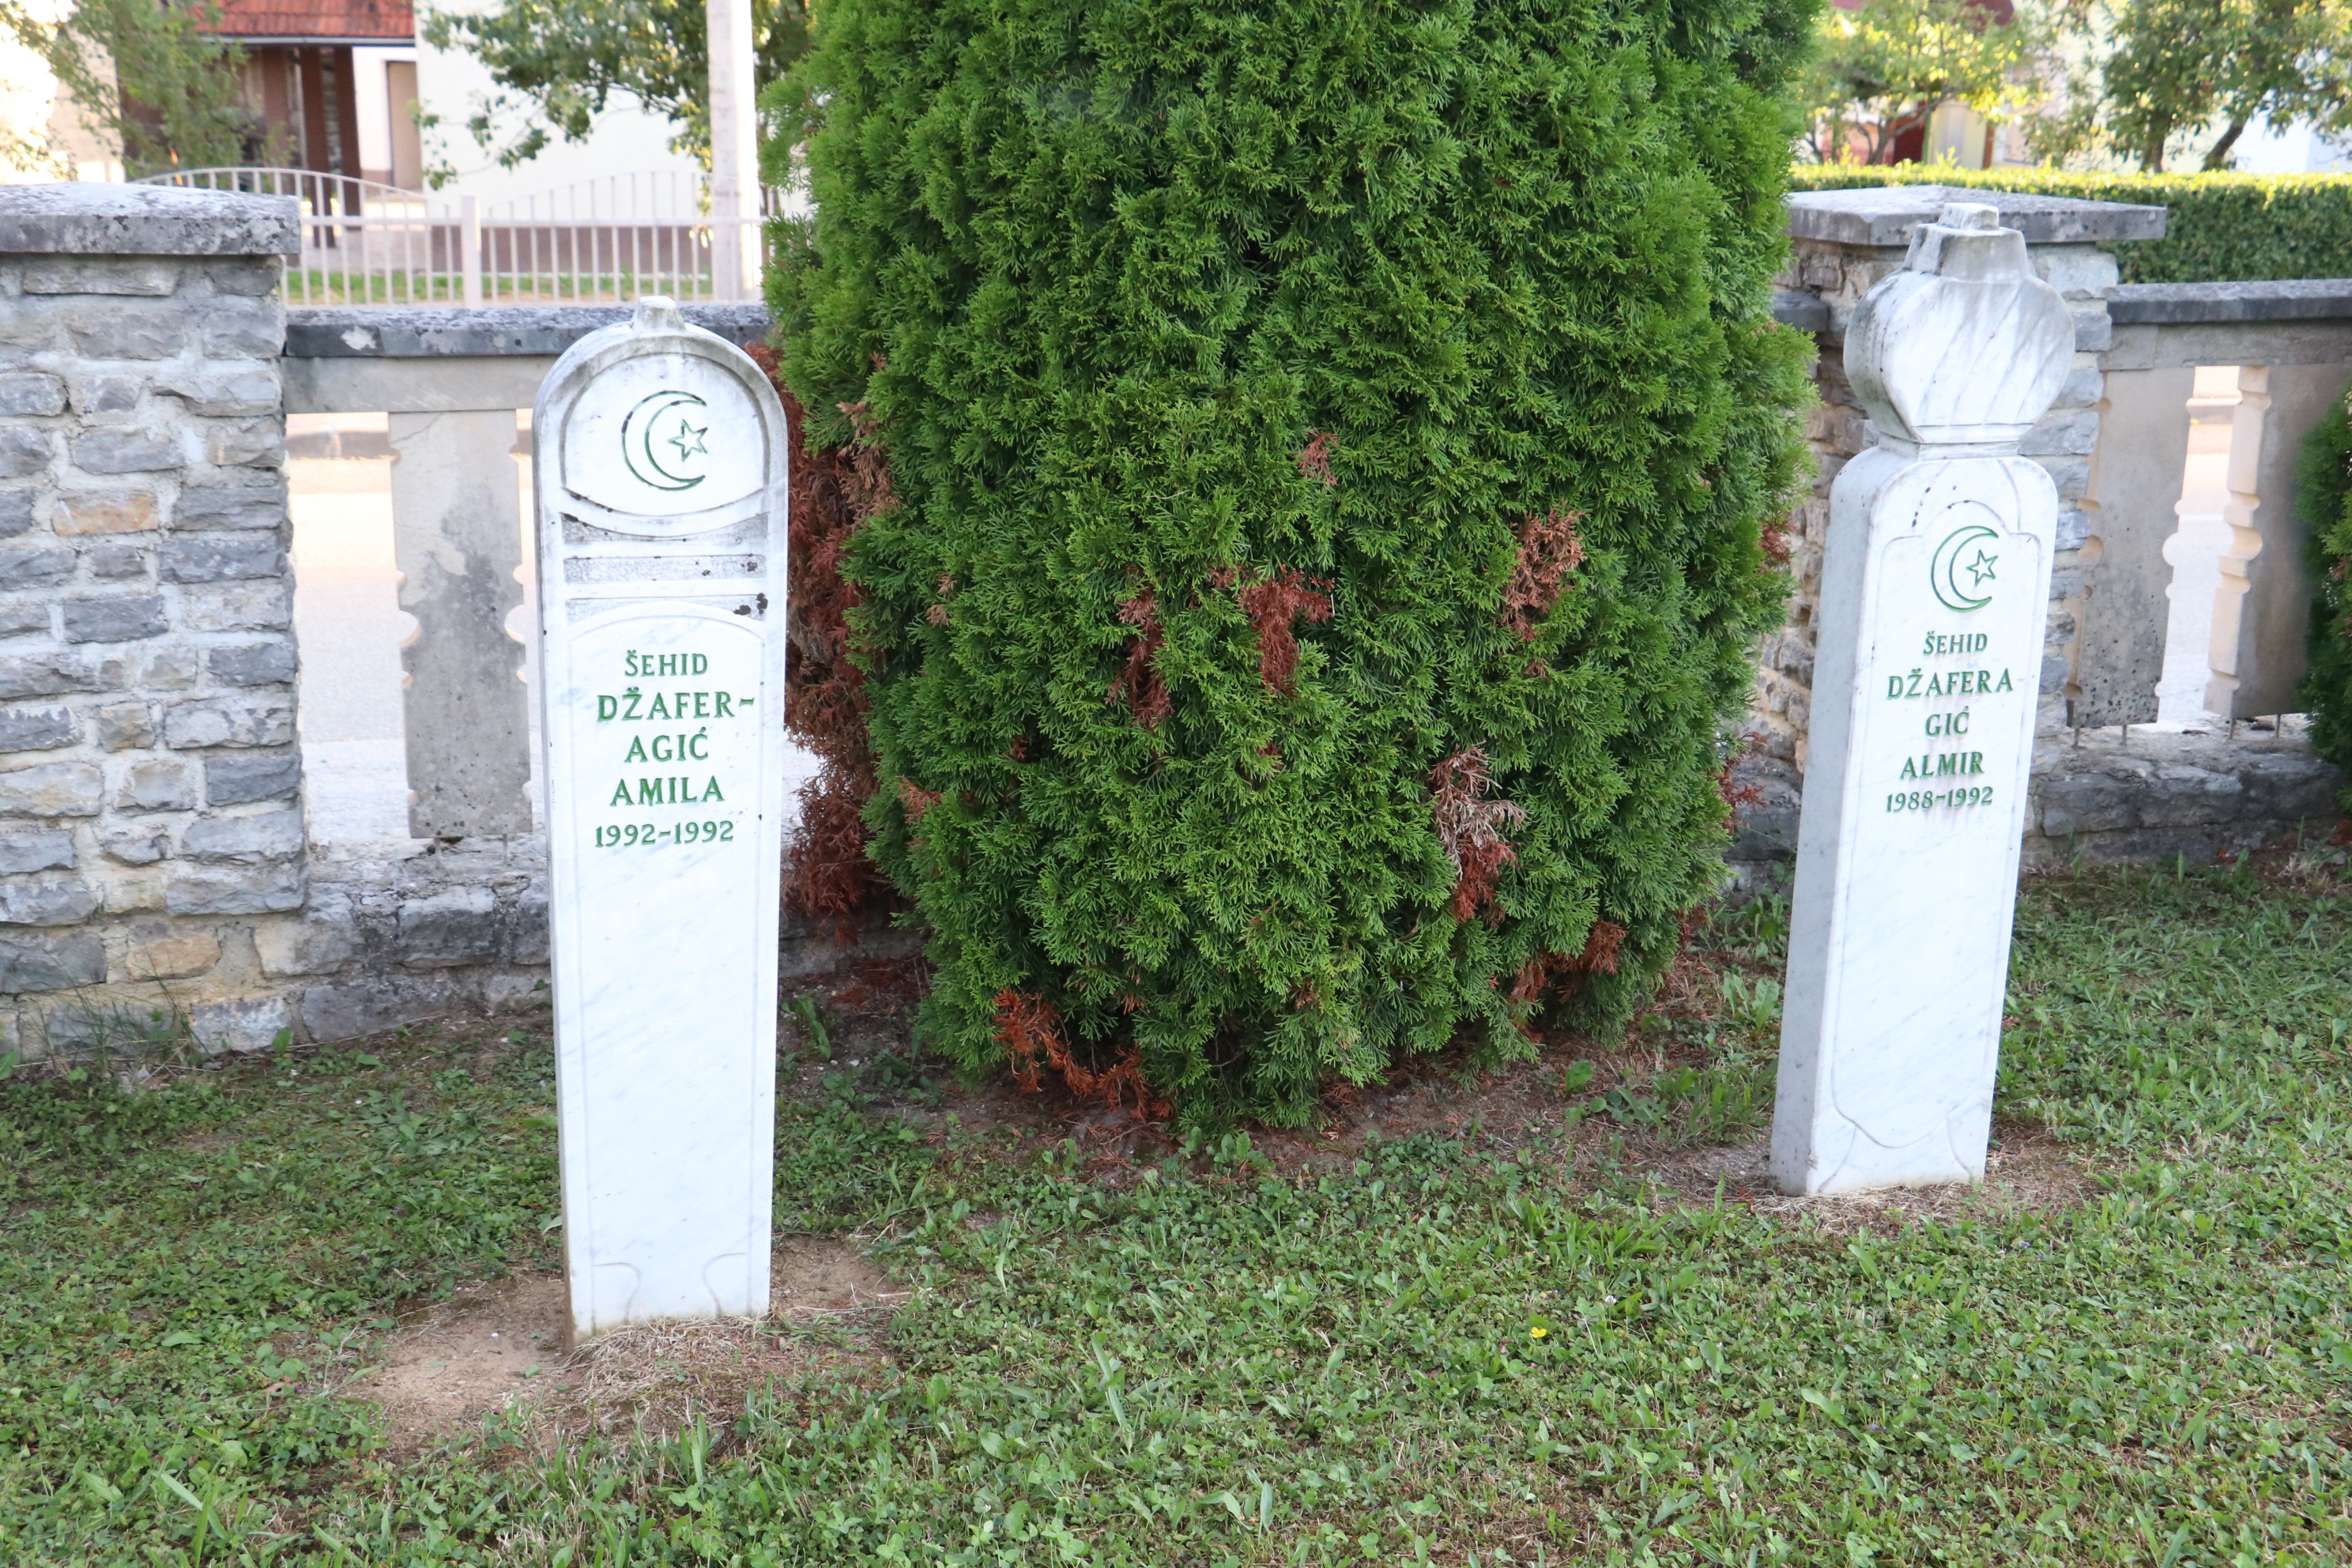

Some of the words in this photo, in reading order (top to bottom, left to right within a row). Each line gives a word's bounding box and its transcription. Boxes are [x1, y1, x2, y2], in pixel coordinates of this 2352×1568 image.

[1923, 630, 1988, 656] ŠEHID
[624, 649, 708, 677] ŠEHID
[1886, 667, 2014, 701] DŽAFERA
[597, 686, 756, 722] DŽAFER-
[1925, 705, 1970, 737] GIĆ
[624, 726, 709, 763] AGIĆ
[1899, 751, 1985, 780] ALMIR
[609, 775, 726, 807] AMILA
[1885, 786, 1994, 813] 1988-1992
[595, 820, 734, 848] 1992-1992
